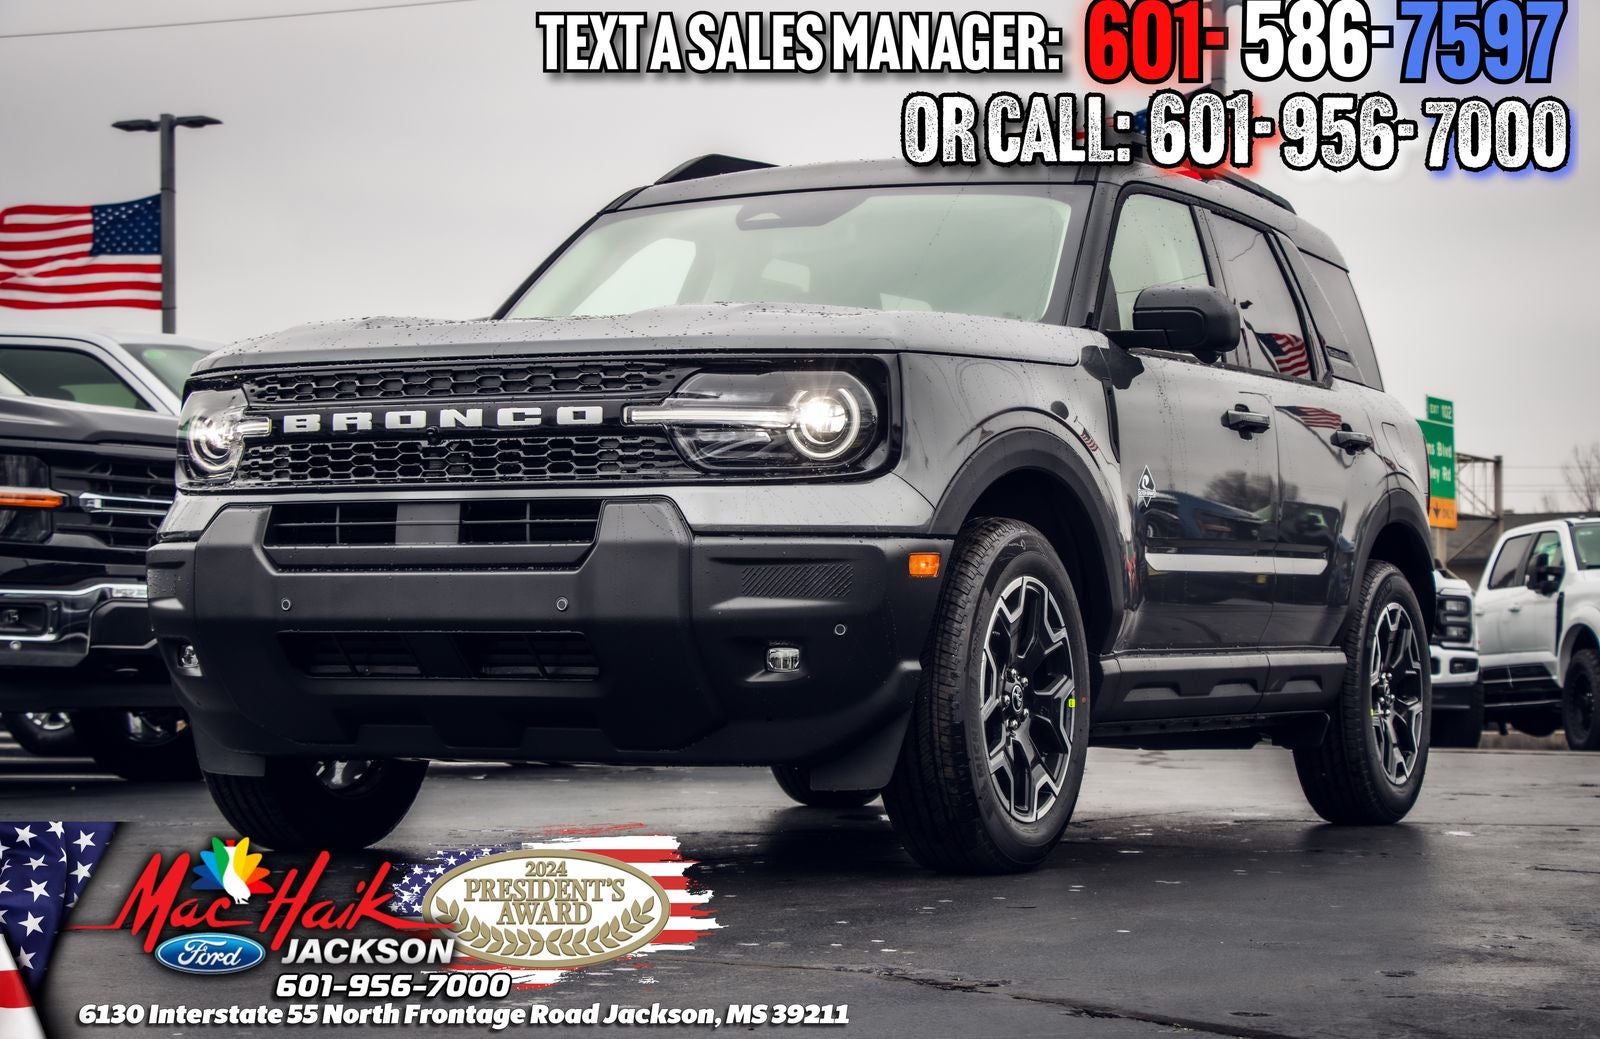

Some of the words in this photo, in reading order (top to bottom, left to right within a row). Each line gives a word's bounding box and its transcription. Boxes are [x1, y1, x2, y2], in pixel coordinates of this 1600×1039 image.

[283, 406, 603, 433] BRONCO
[1441, 404, 1452, 419] 102
[1436, 441, 1452, 458] Blvd
[1441, 466, 1451, 481] Rd
